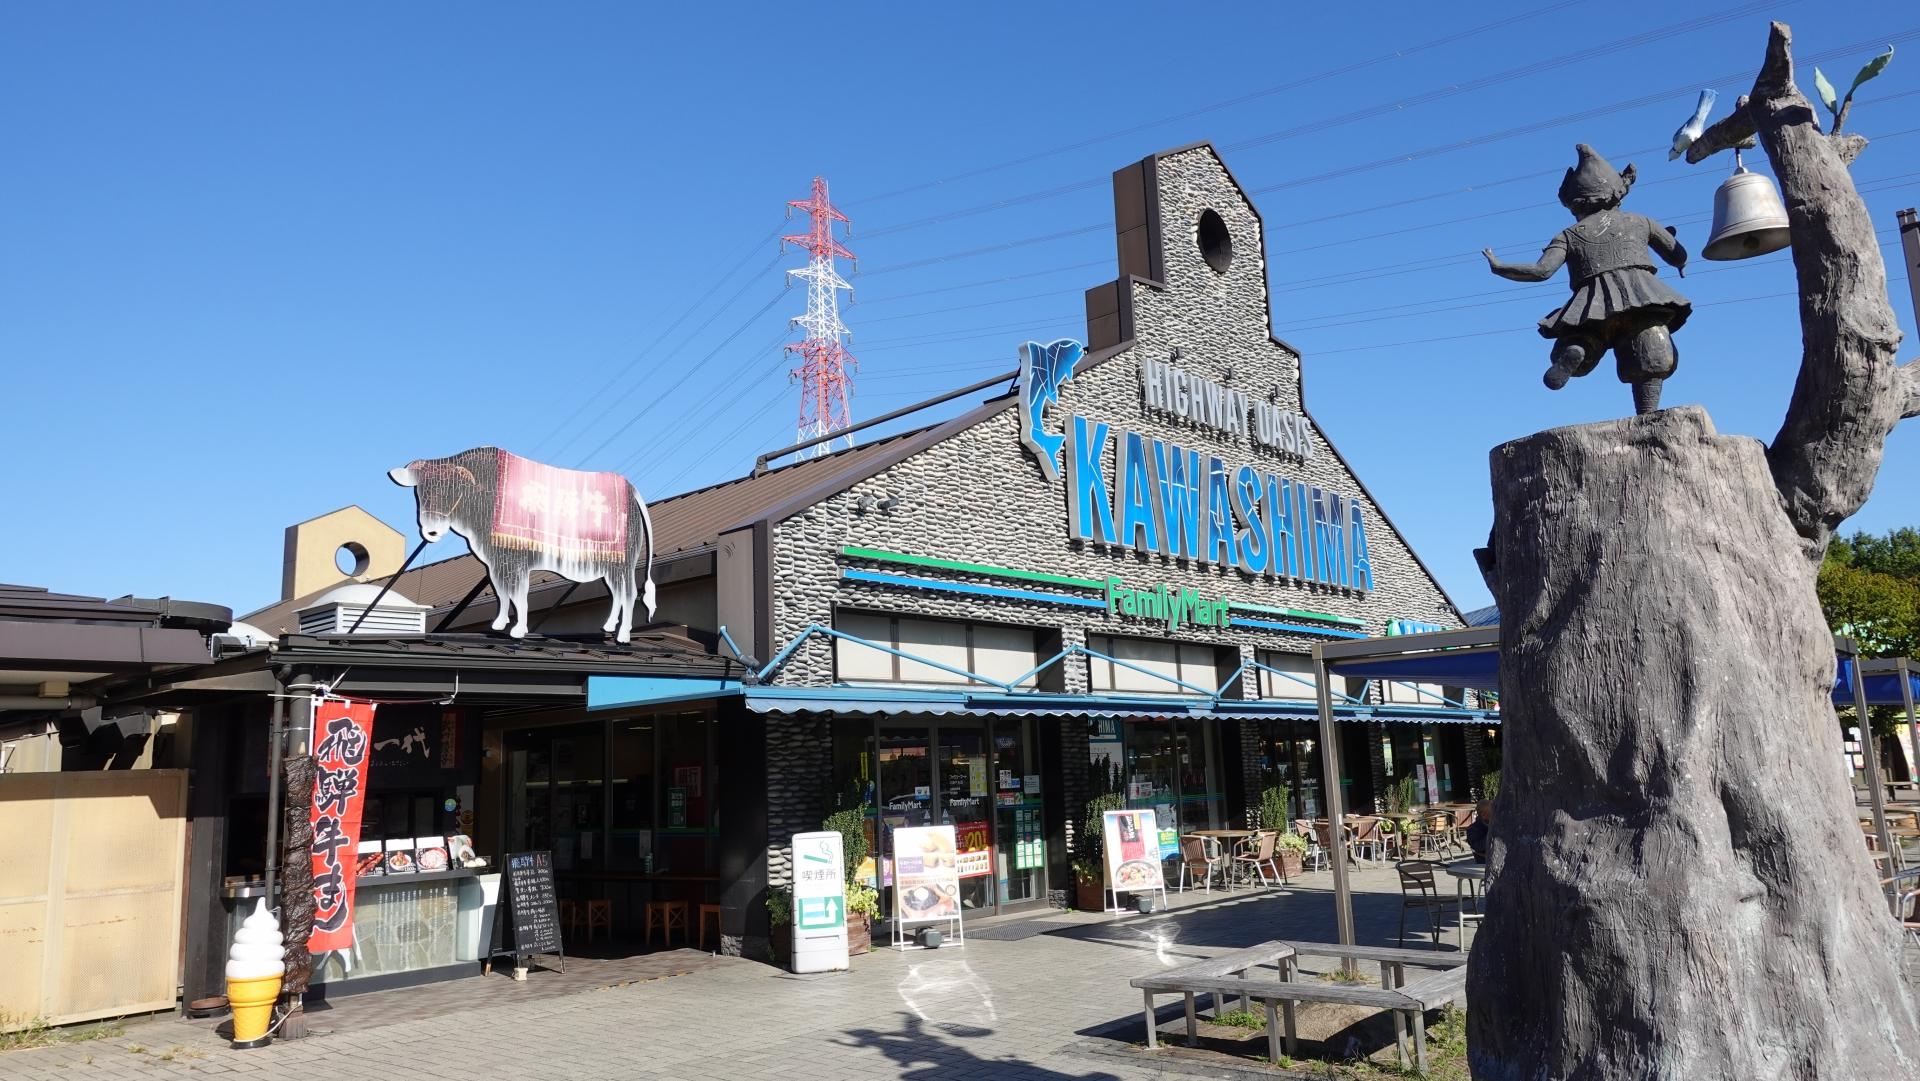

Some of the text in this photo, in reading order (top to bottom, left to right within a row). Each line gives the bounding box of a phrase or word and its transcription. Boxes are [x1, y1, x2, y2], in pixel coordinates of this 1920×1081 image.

[1144, 358, 1315, 460] HIGHWAY OASIS
[1065, 415, 1373, 592] KAWASHIMA
[1106, 575, 1230, 632] FamilyMart
[889, 799, 923, 811] FamilyMart
[949, 797, 980, 807] FamilyMart
[801, 868, 836, 881] 喫煙所
